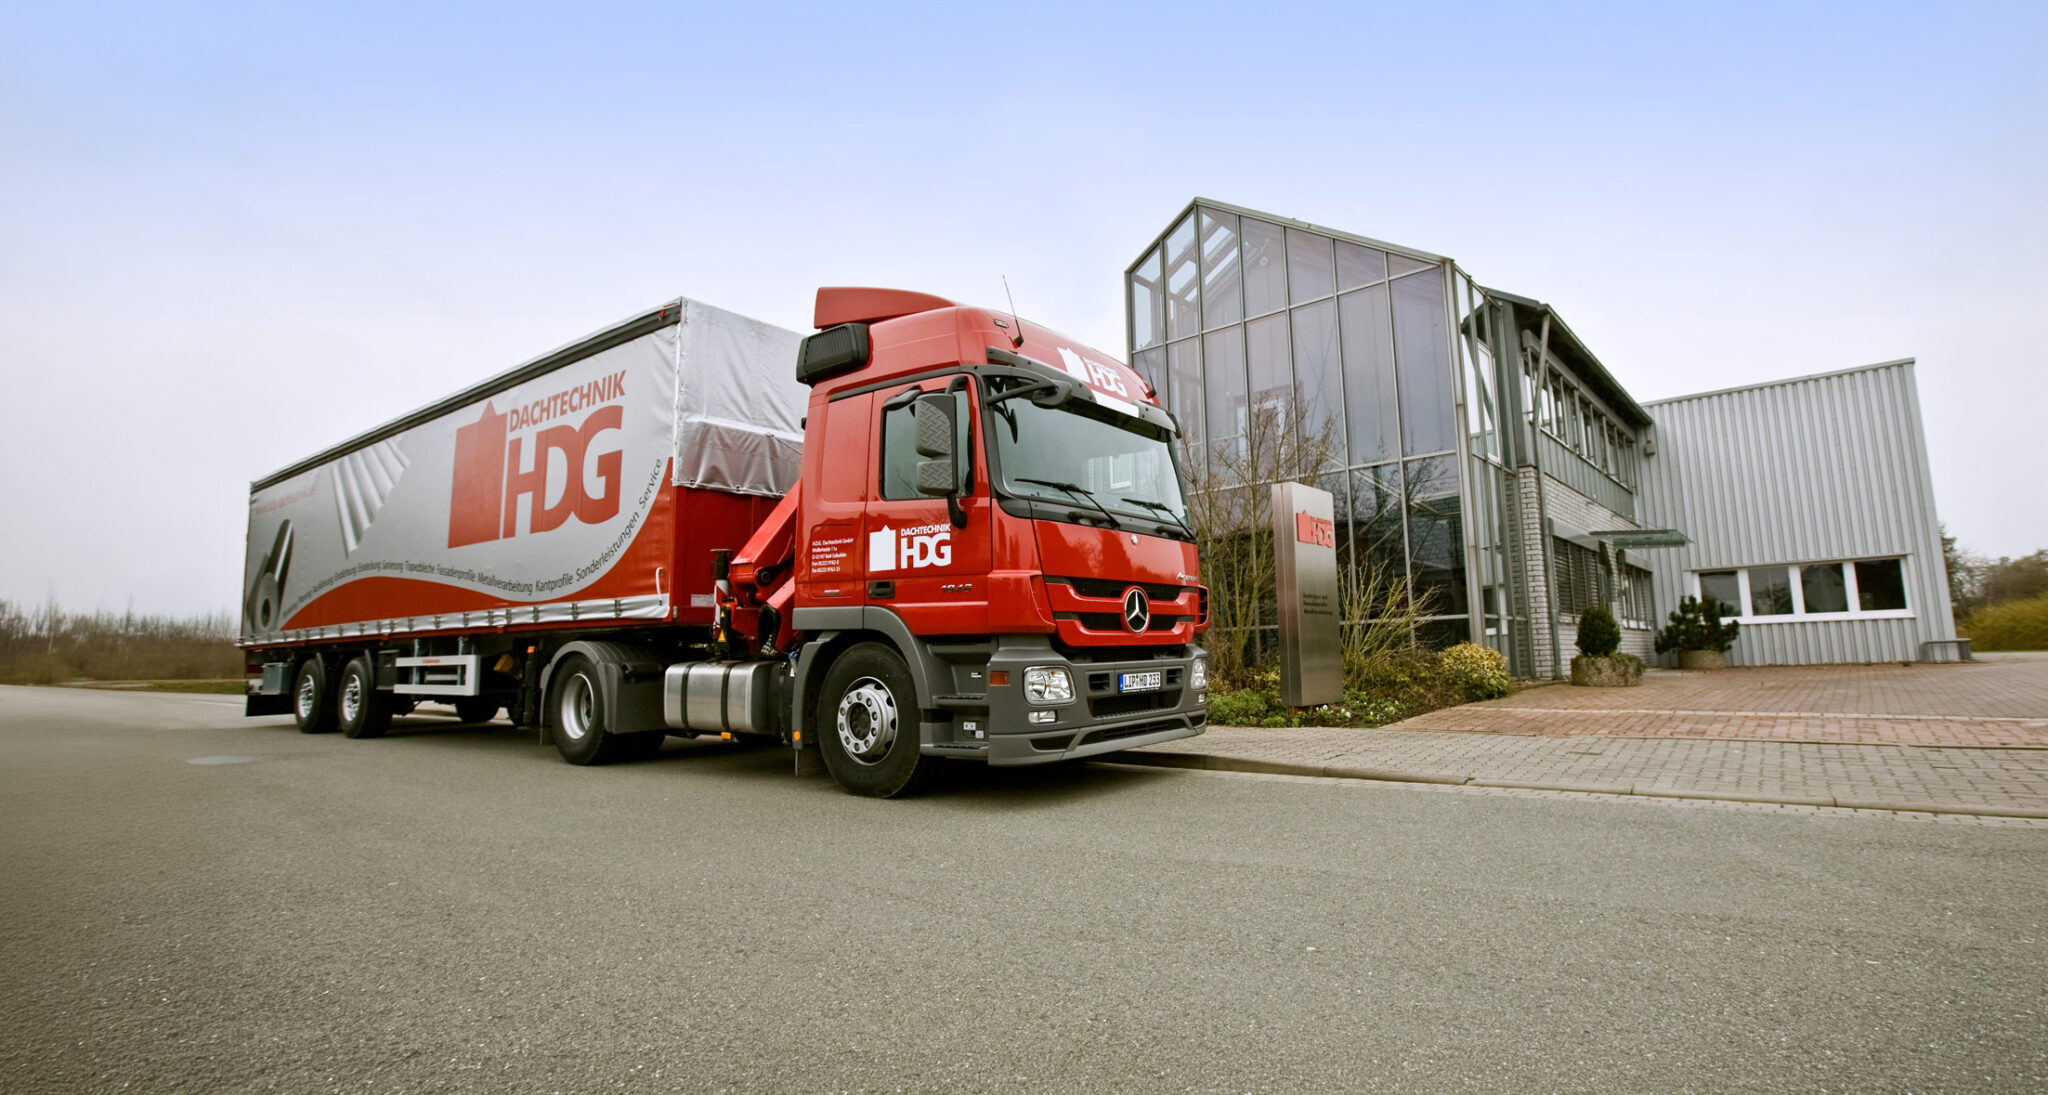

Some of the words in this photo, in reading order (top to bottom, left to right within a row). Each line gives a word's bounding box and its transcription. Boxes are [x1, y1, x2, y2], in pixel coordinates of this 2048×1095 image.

[509, 369, 626, 433] DACHTECHNIK
[502, 405, 624, 539] HDG
[477, 572, 533, 596] Metallverarbeitung
[535, 573, 574, 593] Kantprofile
[575, 511, 640, 582] Sonderleistungen
[638, 458, 662, 509] Service
[900, 523, 951, 537] DACHTECHNIK
[900, 532, 952, 569] HDG
[1124, 675, 1136, 688] LIP
[1139, 674, 1148, 687] HD
[1149, 673, 1160, 686] 233
